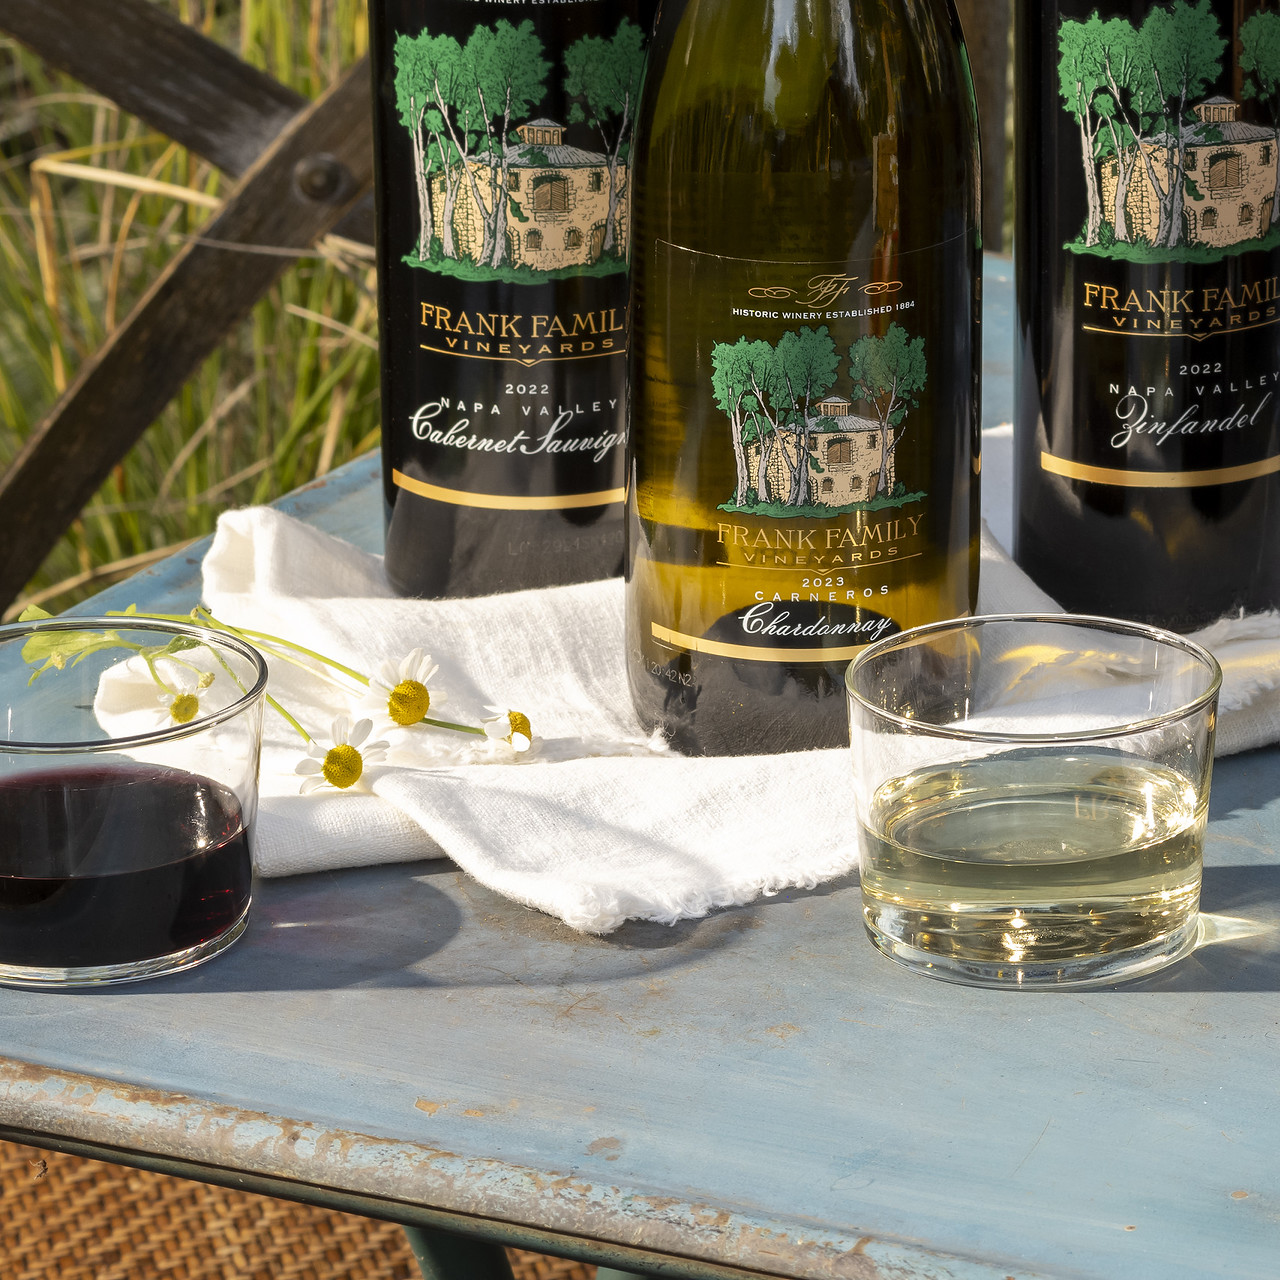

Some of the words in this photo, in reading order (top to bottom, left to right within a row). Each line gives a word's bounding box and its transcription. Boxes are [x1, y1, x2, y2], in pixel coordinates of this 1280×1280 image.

[1084, 282, 1194, 313] FRANK
[420, 301, 522, 338] FRANK
[530, 308, 624, 338] FAMIL
[732, 307, 779, 319] HISTORIC
[781, 312, 823, 320] WINERY
[825, 305, 892, 319] ESTABLISHED
[895, 300, 915, 311] 1884
[1112, 306, 1276, 329] VINEYARDS
[445, 337, 614, 354] VINEYARDS
[1179, 362, 1222, 375] 2022
[505, 384, 550, 395] 2022
[1109, 383, 1174, 397] NAPA
[1195, 371, 1280, 396] VALLEY
[440, 397, 501, 415] NAPA
[521, 399, 618, 416] VALLEY
[408, 402, 530, 453] Cabernet
[1110, 391, 1273, 448] Zinfandel
[716, 522, 816, 550] FRANK
[825, 512, 926, 549] FAMILY
[743, 546, 899, 565] VINEYARDS
[802, 576, 845, 588] 2023
[754, 585, 889, 602] CARNEROS
[737, 601, 892, 641] Chardonnay
